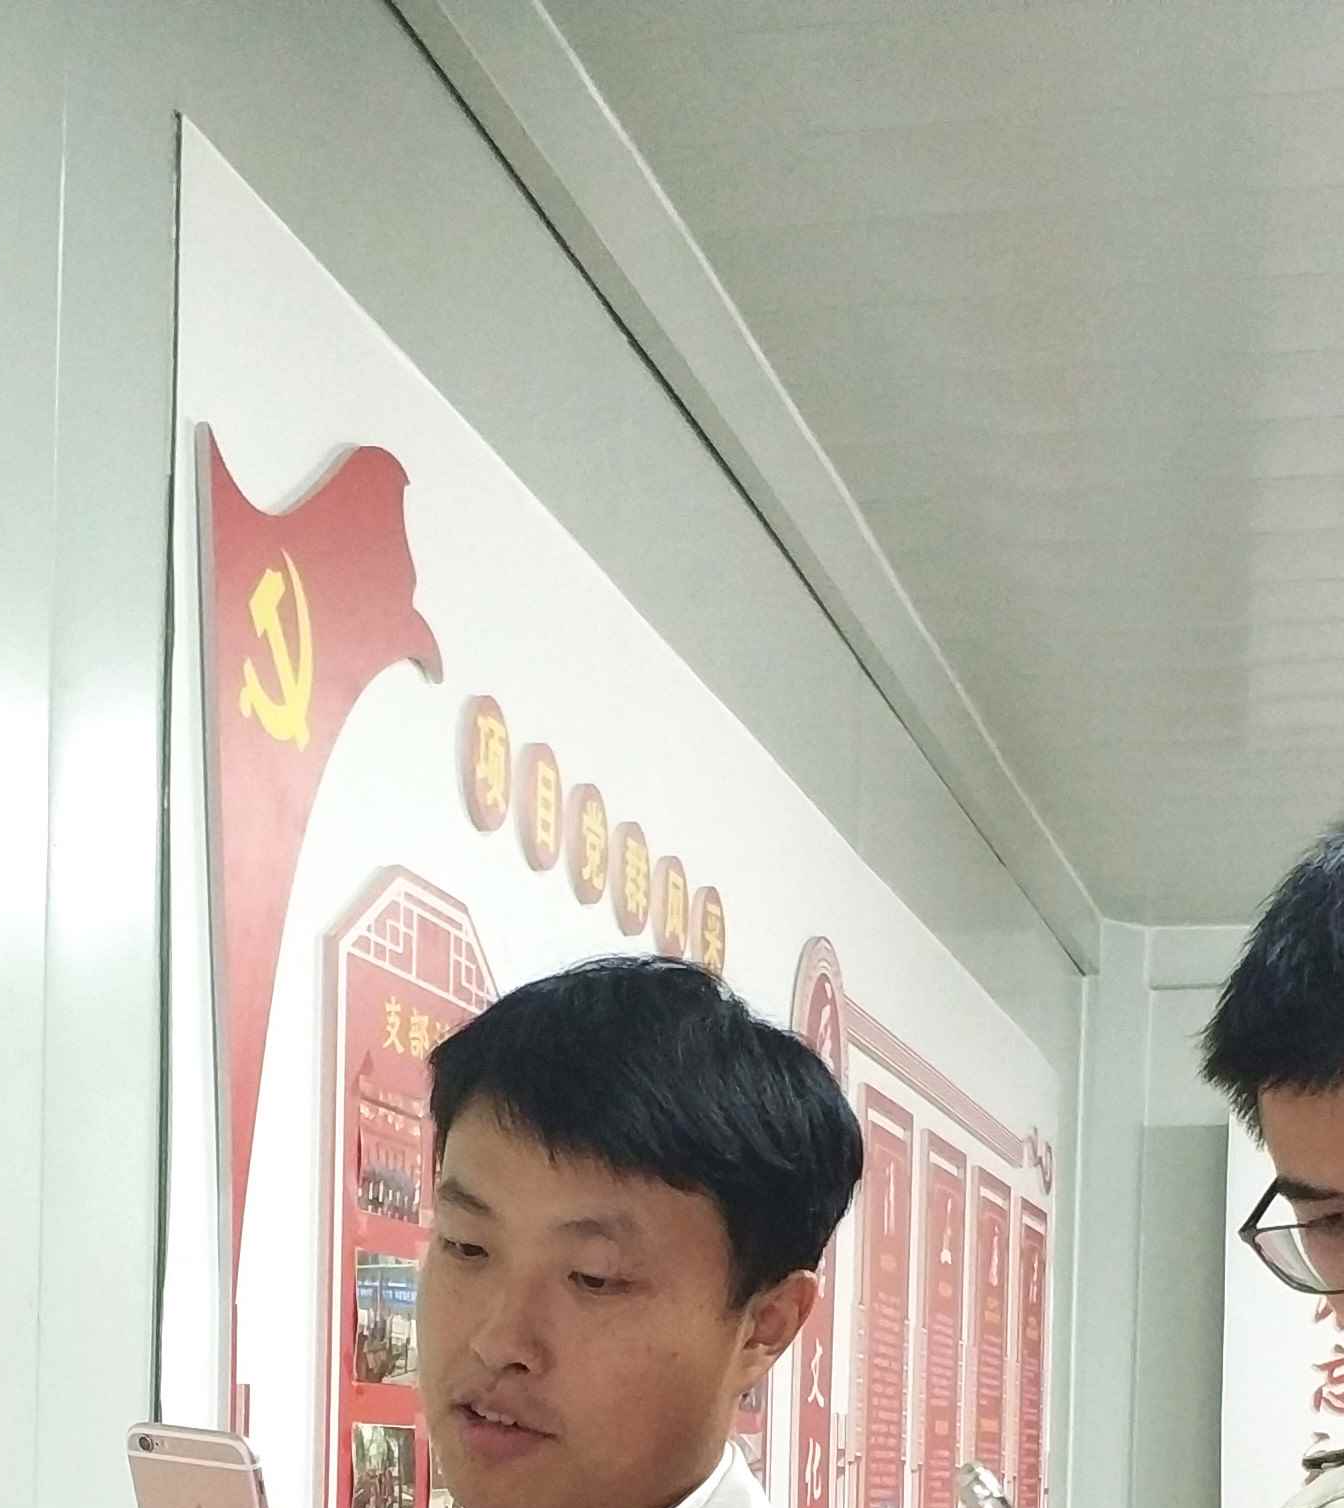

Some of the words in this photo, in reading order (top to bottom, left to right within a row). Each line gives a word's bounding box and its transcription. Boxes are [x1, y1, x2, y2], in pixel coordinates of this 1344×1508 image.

[475, 714, 724, 973] 项目党群风采
[382, 996, 449, 1060] 支部
